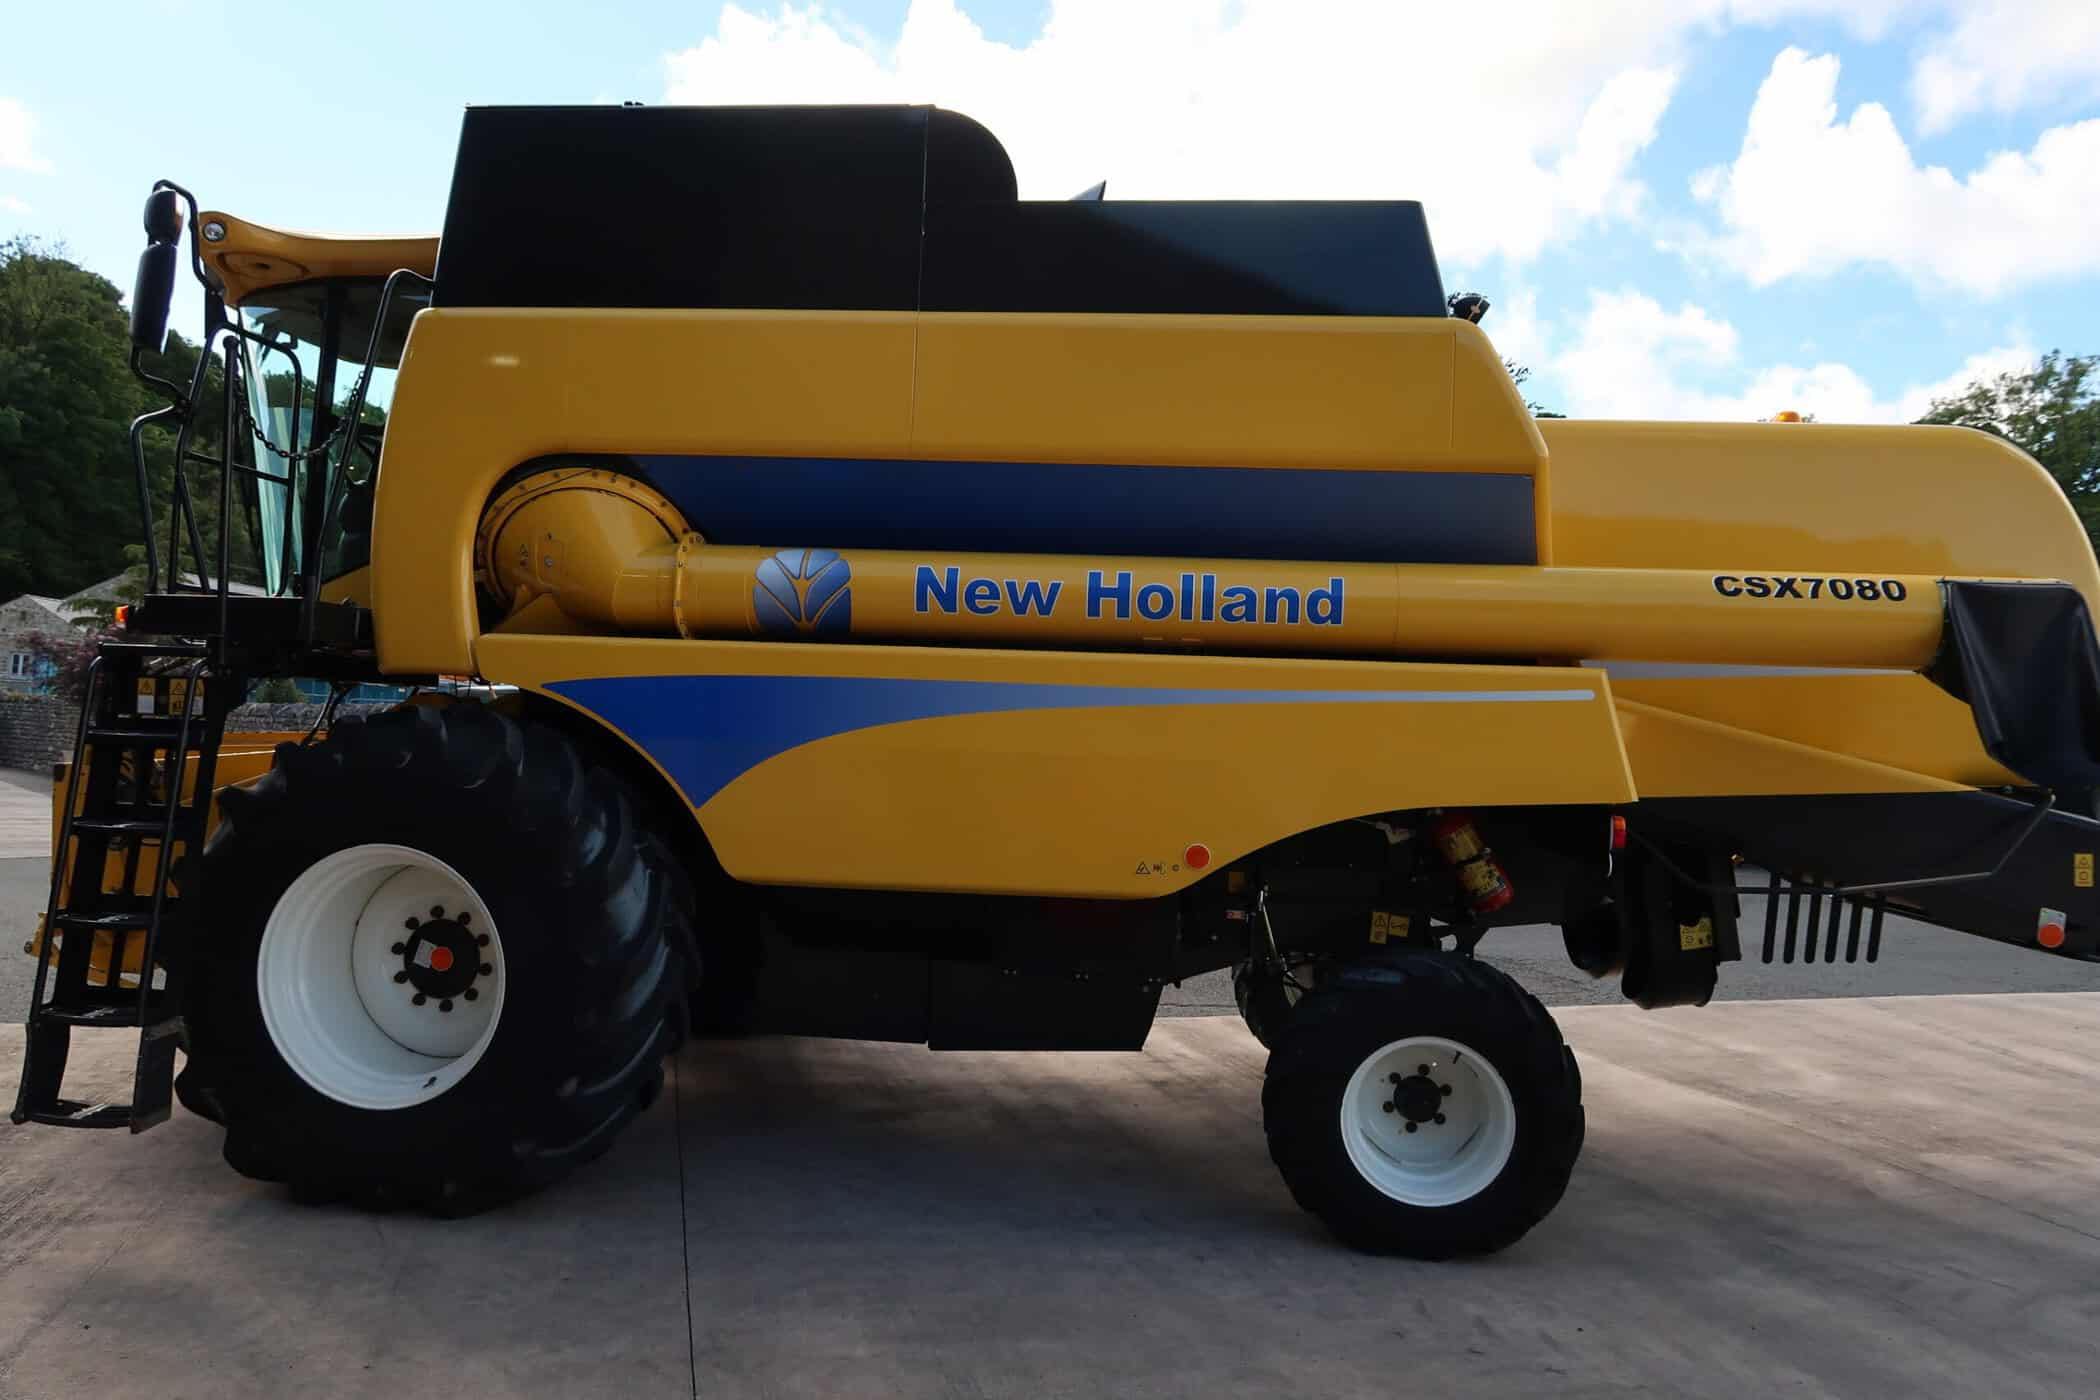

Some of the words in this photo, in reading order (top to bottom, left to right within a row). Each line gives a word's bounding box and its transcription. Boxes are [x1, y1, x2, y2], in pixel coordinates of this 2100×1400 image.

[914, 565, 1063, 617] New
[1086, 570, 1345, 625] Holland
[1713, 575, 1907, 602] CSX7080
